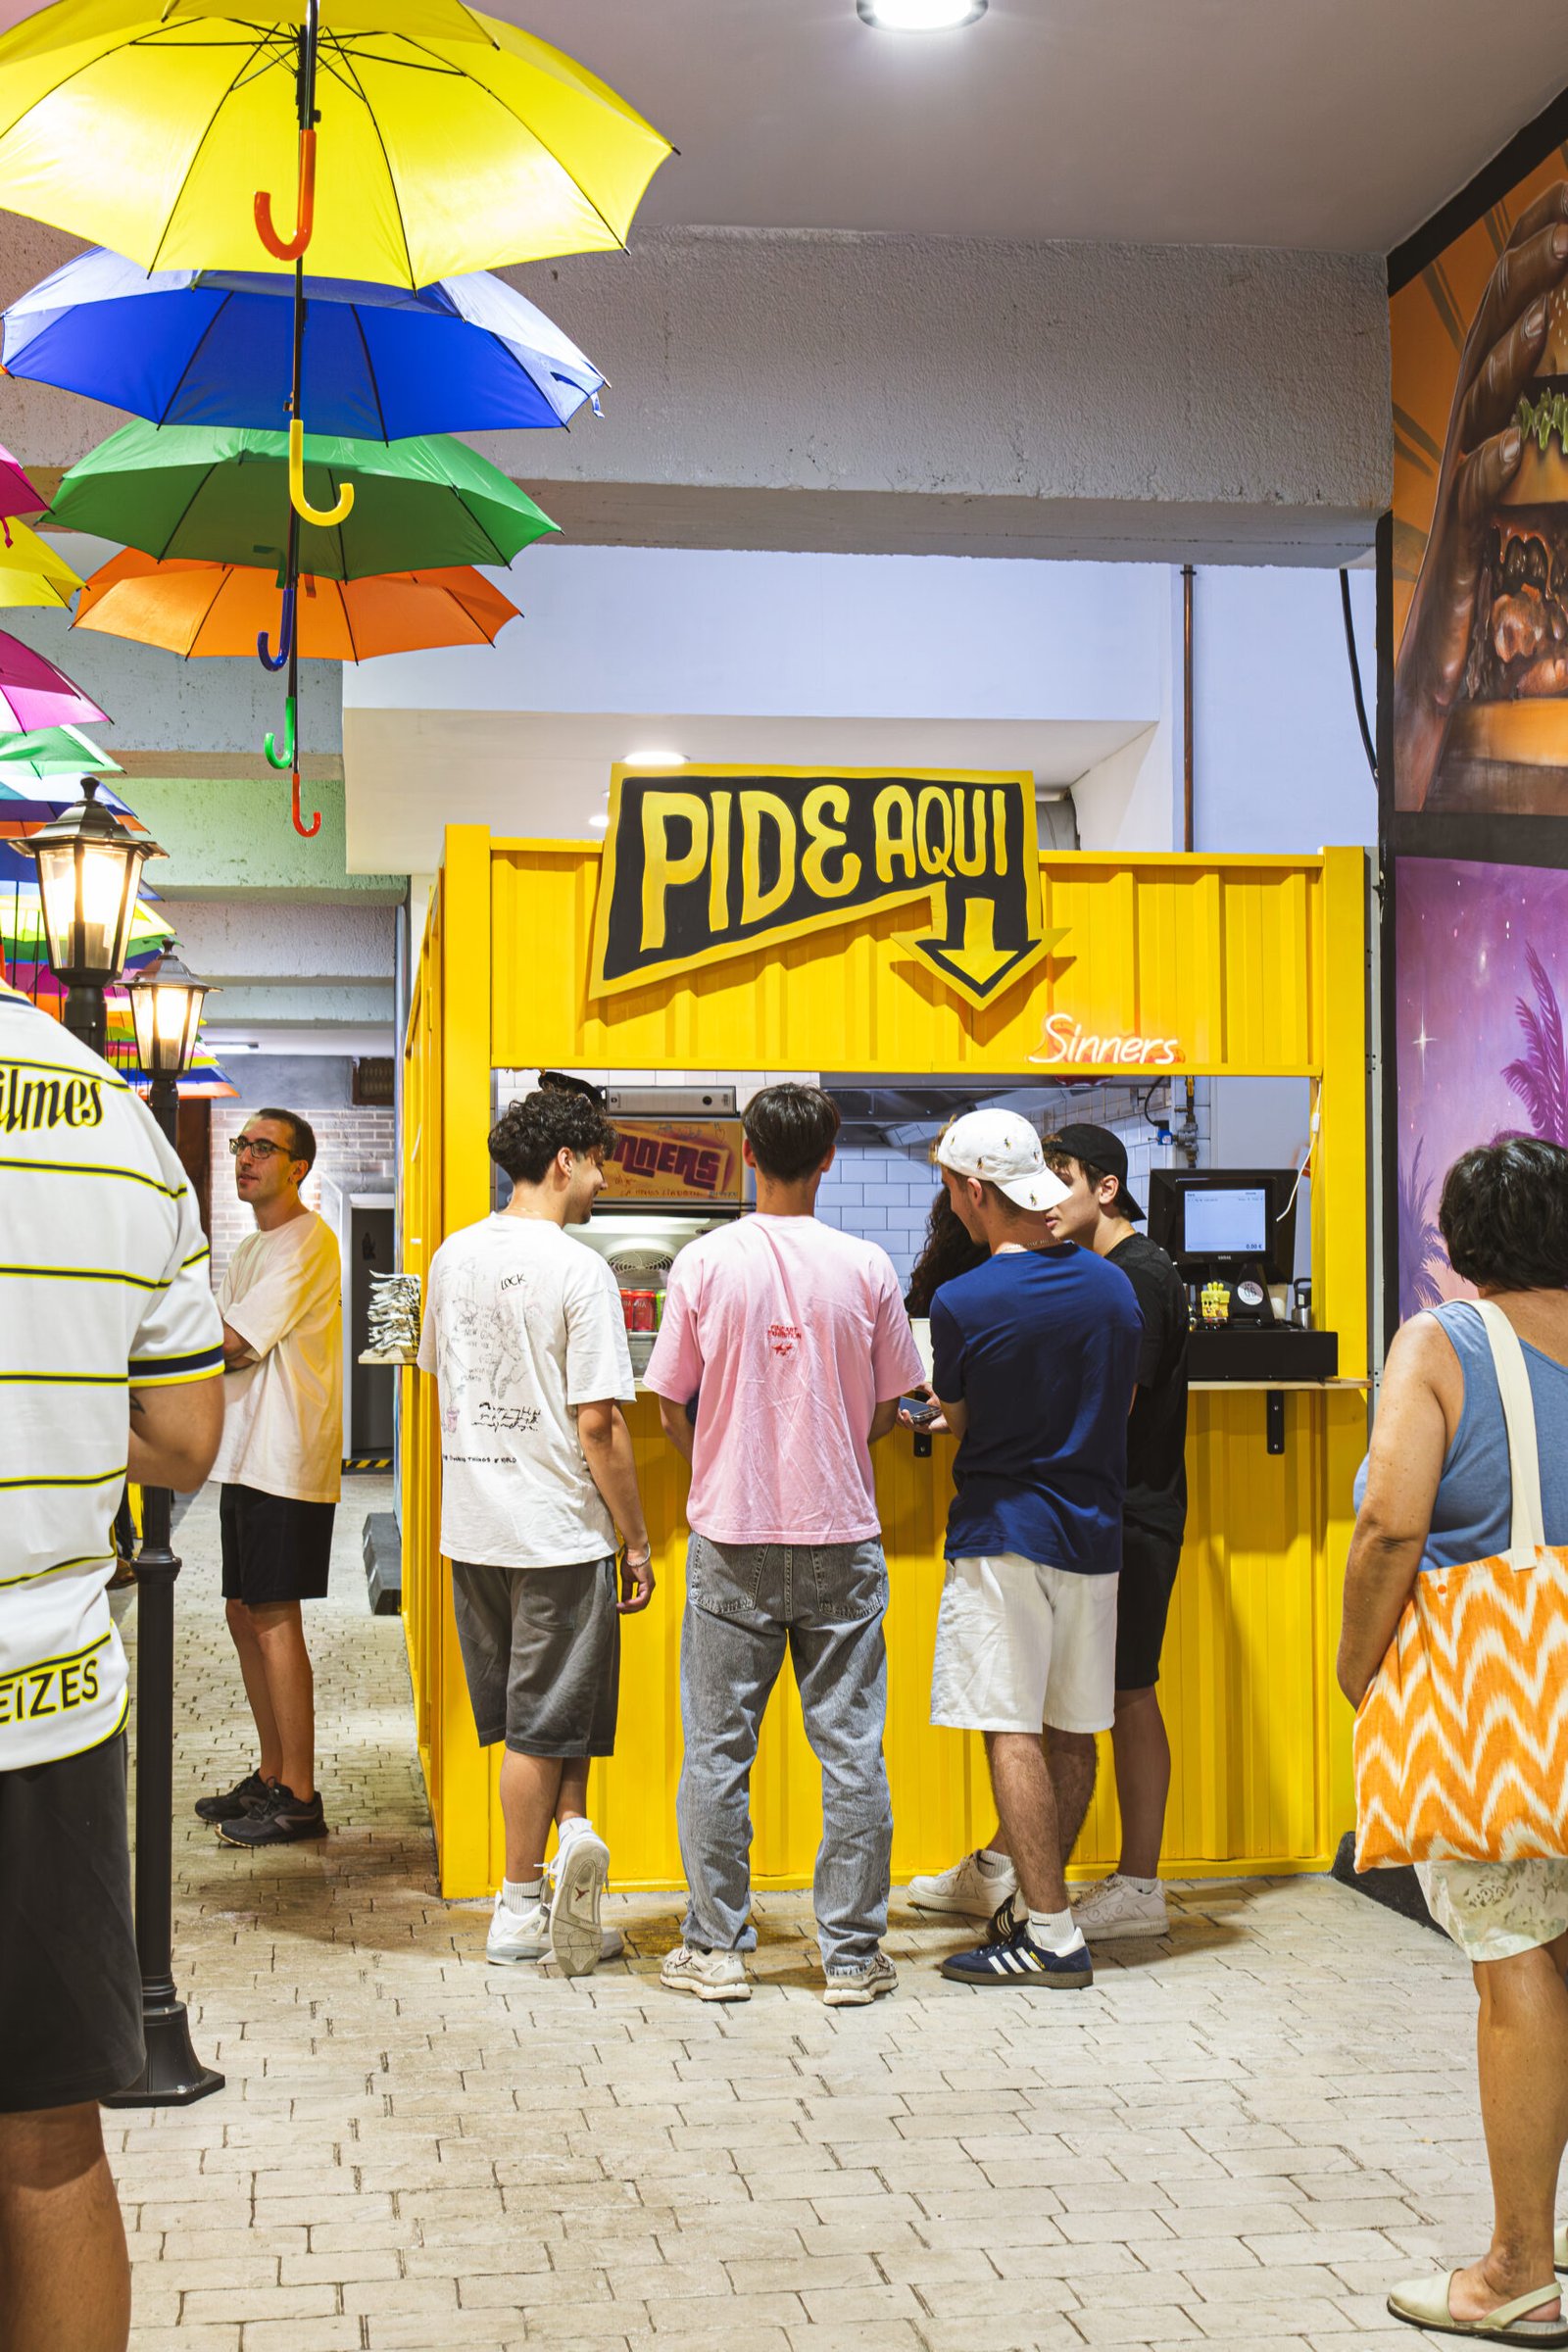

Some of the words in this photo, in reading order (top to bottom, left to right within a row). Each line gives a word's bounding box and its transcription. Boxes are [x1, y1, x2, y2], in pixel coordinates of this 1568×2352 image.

[640, 784, 861, 953] PIDE
[873, 784, 1008, 883] AQUI
[1028, 1012, 1179, 1065] Sinners
[501, 1274, 527, 1291] LOCK
